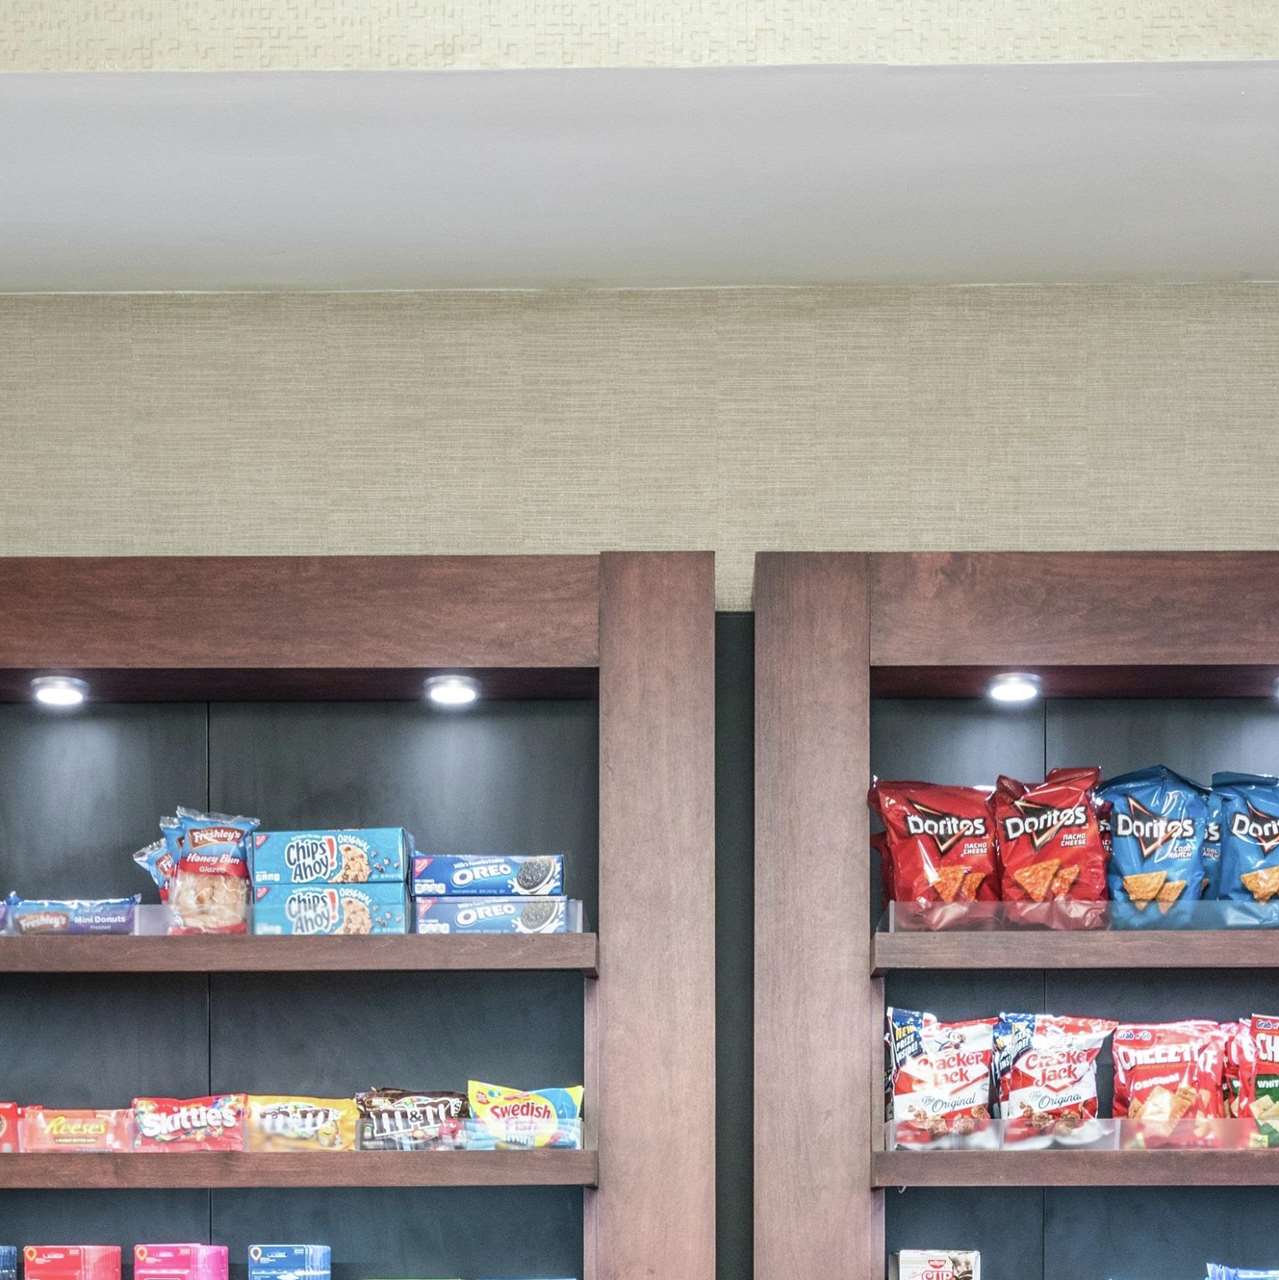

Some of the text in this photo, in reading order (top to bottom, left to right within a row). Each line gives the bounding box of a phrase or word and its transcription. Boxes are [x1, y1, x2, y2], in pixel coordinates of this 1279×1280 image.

[907, 814, 986, 836] Doritos
[1005, 805, 1087, 839] Doritos
[1117, 814, 1194, 838] Doritos
[193, 829, 242, 843] Freshley's
[1061, 839, 1087, 847] CHEESE
[186, 853, 216, 866] Honey
[286, 841, 327, 865] Chips
[451, 864, 512, 887] OREO
[287, 890, 327, 916] Chips
[95, 914, 126, 924] Donuts
[455, 903, 517, 928] OREO
[140, 1108, 237, 1137] Skittles
[489, 1102, 552, 1120] Swedish
